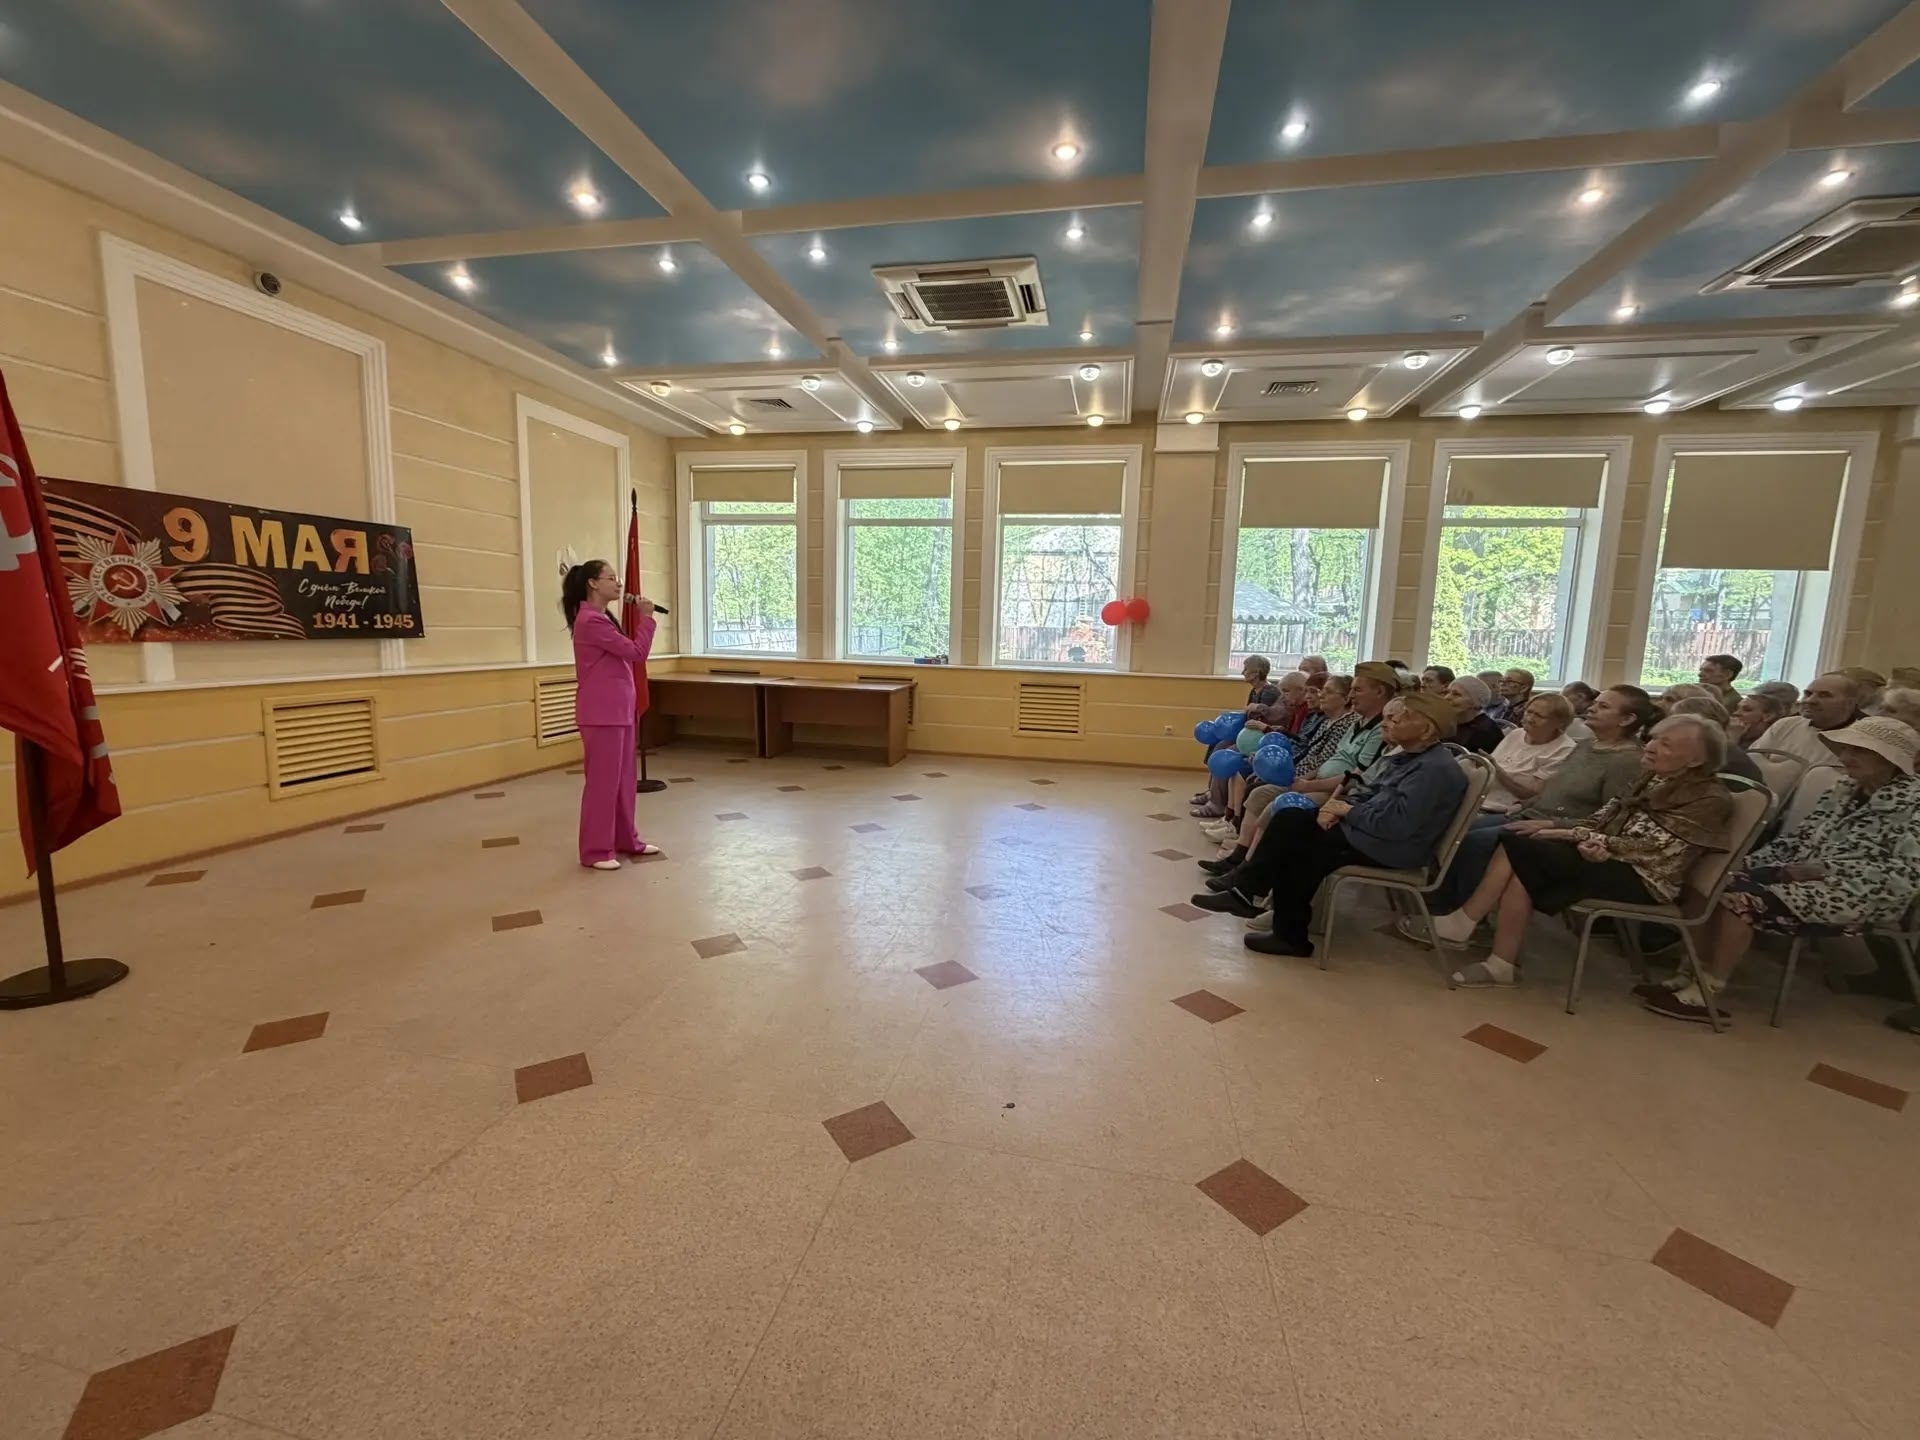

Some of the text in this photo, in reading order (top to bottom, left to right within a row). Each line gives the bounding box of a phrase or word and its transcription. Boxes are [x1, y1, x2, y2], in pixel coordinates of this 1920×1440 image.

[163, 507, 370, 574] 9 МАЯ
[298, 578, 309, 593] С
[312, 613, 359, 629] 1941
[373, 613, 415, 629] 1945
